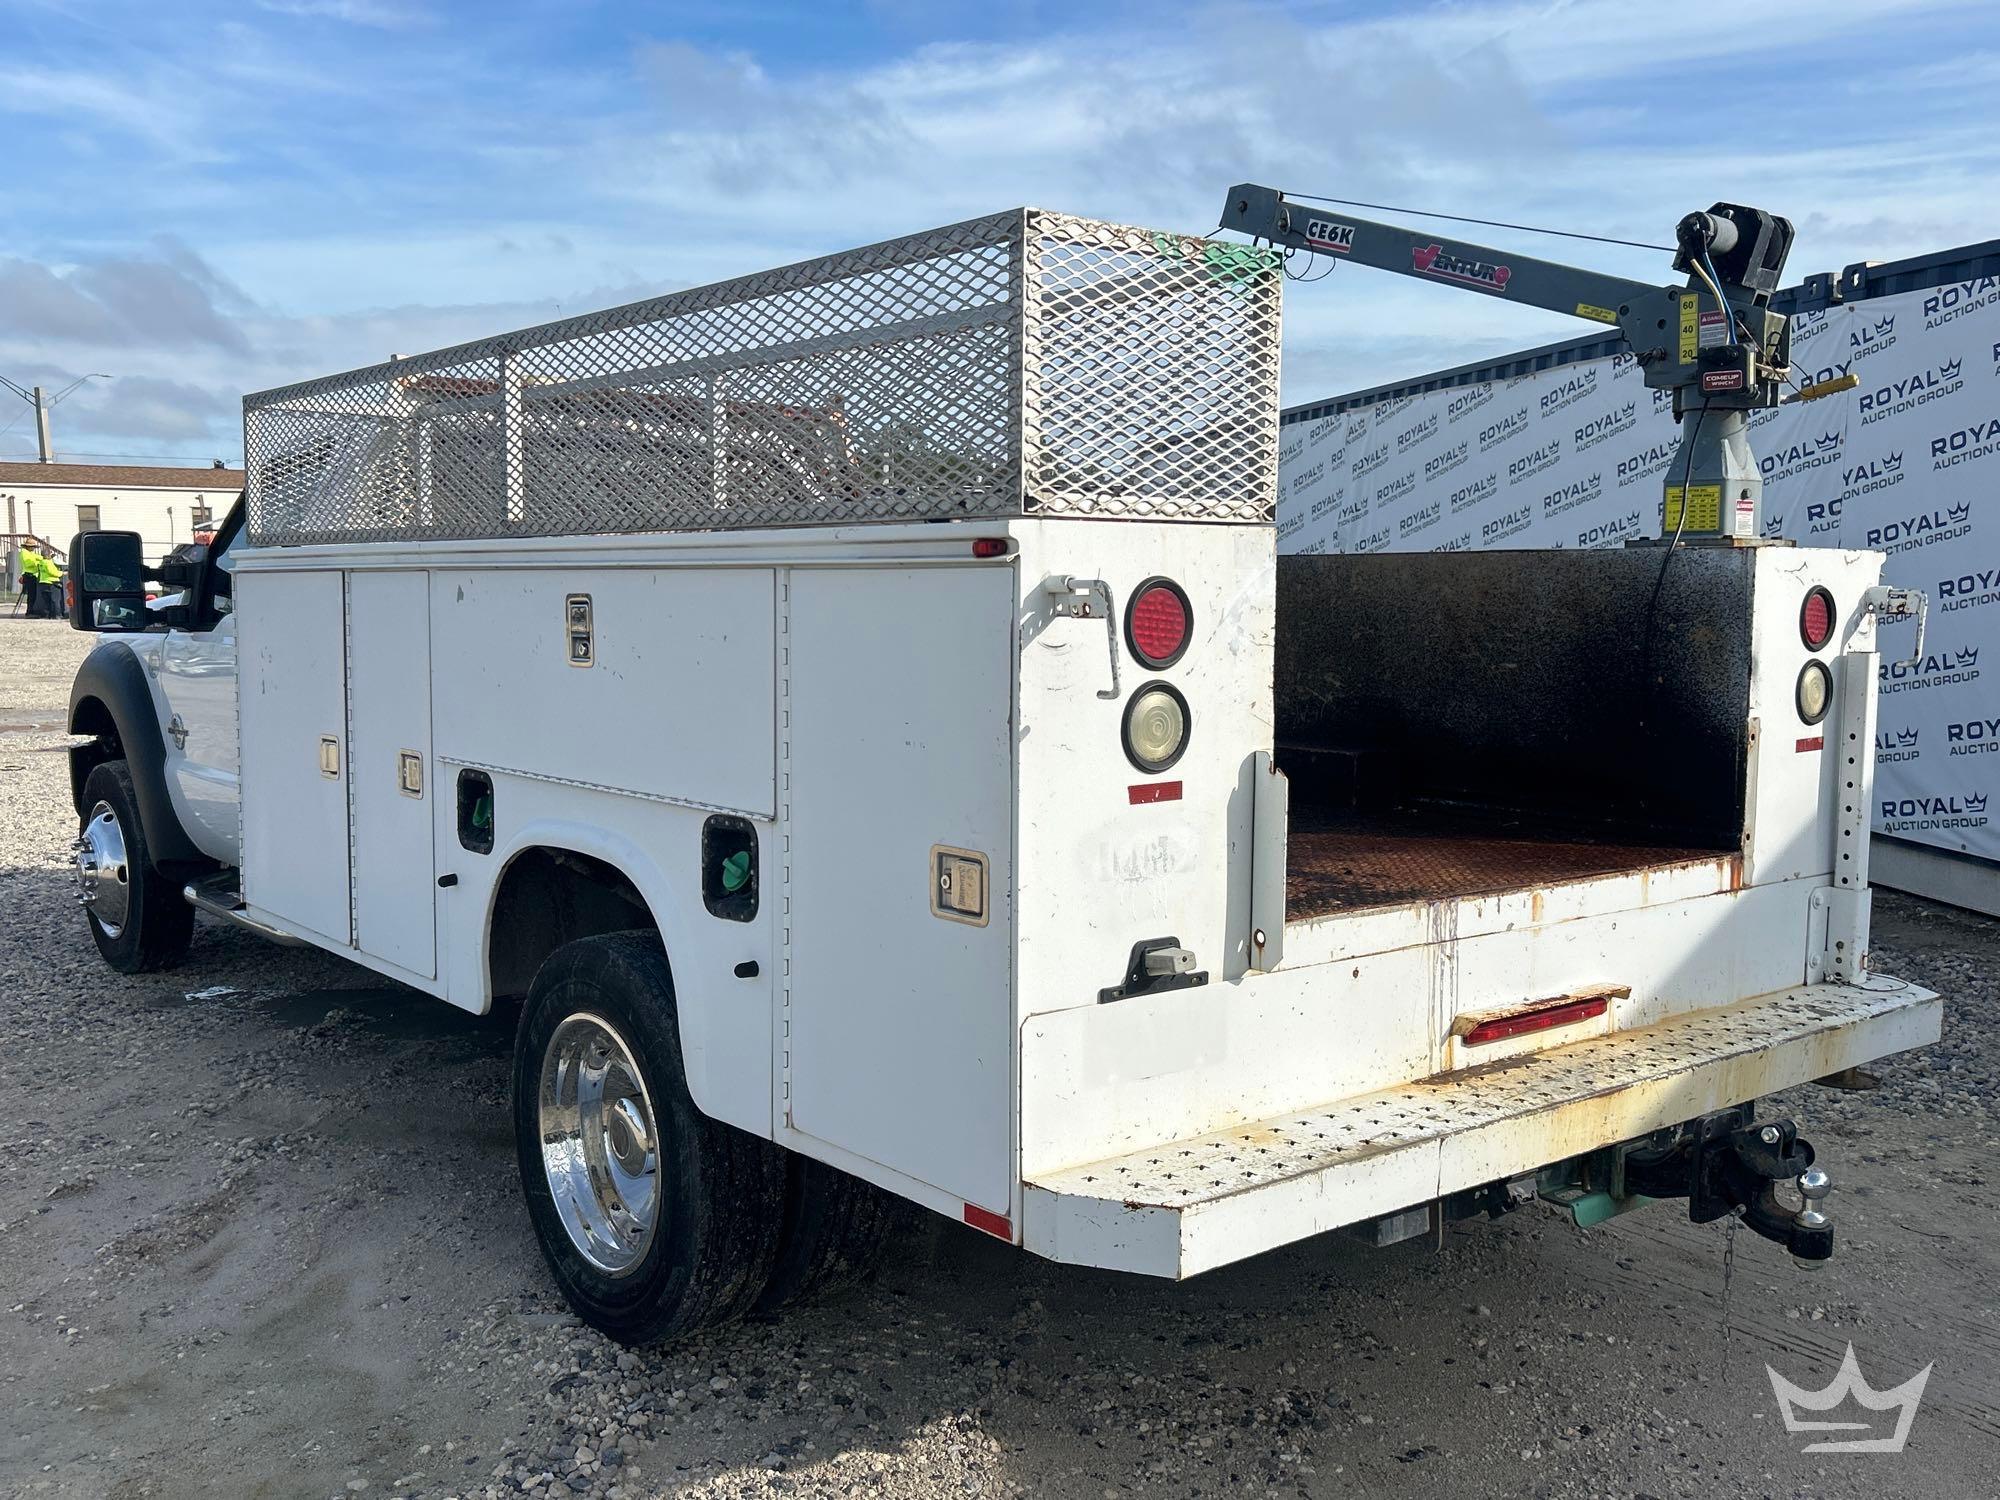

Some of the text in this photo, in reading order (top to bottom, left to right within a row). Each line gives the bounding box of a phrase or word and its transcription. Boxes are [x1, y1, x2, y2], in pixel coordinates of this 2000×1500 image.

[1308, 221, 1354, 245] CE6K
[1413, 244, 1512, 286] VENTURO
[1683, 301, 1694, 309] 60
[1923, 276, 2000, 317] ROYA
[1925, 297, 1985, 331] AUCTION
[1683, 325, 1693, 333] 40
[1683, 350, 1693, 358] 20
[1854, 336, 1897, 361] GROUP
[1448, 387, 1483, 416] ROYAL
[1540, 377, 1585, 409] ROYAL
[1541, 384, 1597, 419] AUCTION GROUP
[1860, 370, 1939, 413] ROYAL
[1861, 380, 1964, 426] AUCTION GROUP
[1449, 393, 1494, 424] AUCTION GROUP
[1398, 420, 1429, 447] ROYAL
[1480, 415, 1517, 444] ROYAL
[1480, 421, 1529, 453] AUCTION GROUP
[1575, 410, 1622, 443] ROYAL
[1576, 418, 1637, 453] AUCTION GROUP
[1931, 419, 2000, 458] ROYA
[1279, 444, 1297, 461] OYAL
[1352, 449, 1381, 475] ROYAL
[1425, 448, 1458, 475] ROYAL
[1509, 447, 1549, 477] ROYAL
[1618, 444, 1668, 478] ROYAL
[1757, 441, 1816, 474] OYAL
[1933, 444, 1993, 472] AUCTION
[1293, 467, 1317, 488] ROYAL
[1510, 456, 1560, 486] AUCTION GROUP
[1619, 457, 1673, 488] AUCTION GRO
[1763, 452, 1842, 486] CTION GROUP
[1377, 477, 1407, 501] ROYAL
[1451, 480, 1487, 506] ROYAL
[1544, 480, 1588, 510] ROYAL
[1862, 473, 1904, 495] GROUP
[1312, 495, 1336, 515] ROYAL
[1544, 489, 1601, 519] AUCTION GROUP
[1400, 507, 1431, 531] ROYAL
[1482, 511, 1521, 538] ROYAL
[1867, 511, 1948, 547] ROYAL
[1483, 520, 1532, 546] AUCTION GROUP
[1578, 519, 1627, 547] ROYAL
[1613, 528, 1641, 545] GROUP
[1925, 525, 1972, 544] GROUP
[1941, 592, 2000, 614] AUCTION
[1933, 670, 1980, 686] GROUP
[1947, 719, 2000, 741] ROY
[1877, 750, 1920, 764] GROUP
[1949, 741, 1999, 756] AUCTIO
[1882, 797, 1962, 818] ROYAL
[1884, 817, 1988, 832] AUCTION GROUP
